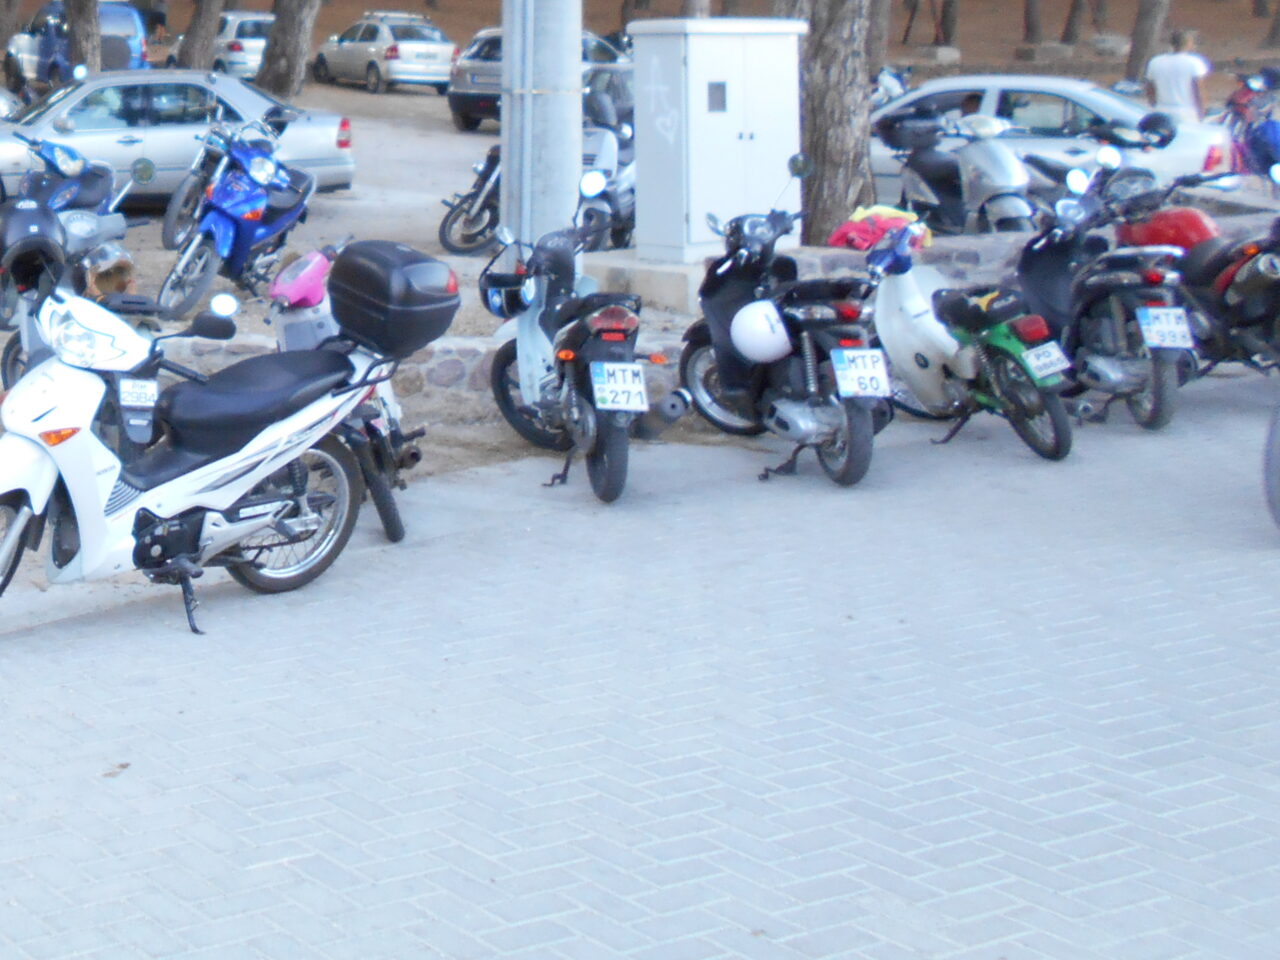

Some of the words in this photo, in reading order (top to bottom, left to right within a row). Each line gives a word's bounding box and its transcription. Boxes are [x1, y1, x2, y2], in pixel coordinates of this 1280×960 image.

[846, 354, 880, 369] MTP
[606, 368, 642, 384] MTM
[857, 375, 880, 391] 60
[609, 390, 644, 405] 271
